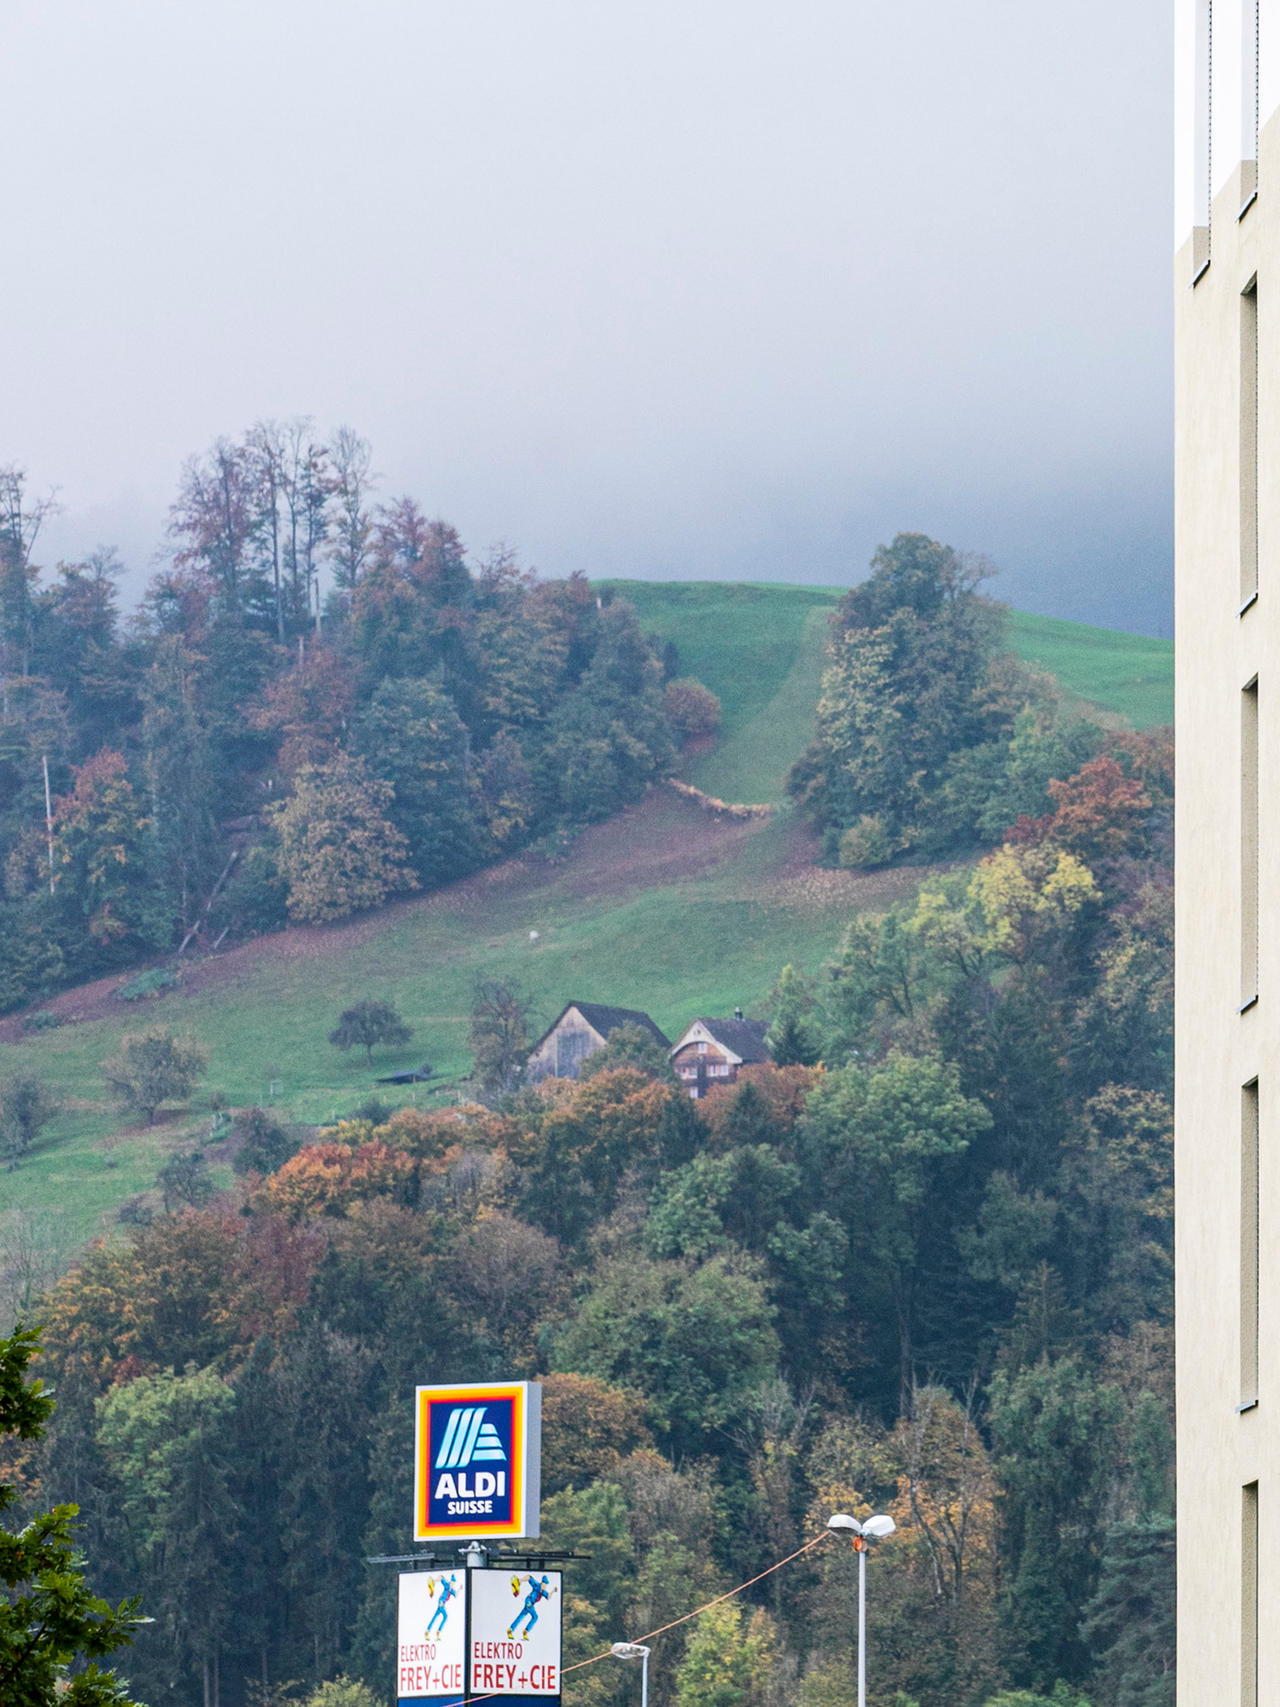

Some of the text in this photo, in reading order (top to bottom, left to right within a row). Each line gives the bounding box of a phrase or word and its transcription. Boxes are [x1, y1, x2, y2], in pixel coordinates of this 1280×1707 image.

[435, 1471, 505, 1499] ALDI
[448, 1500, 493, 1515] SUISSE
[400, 1643, 436, 1662] ELEKTRO
[474, 1642, 523, 1660] ELEKTRO
